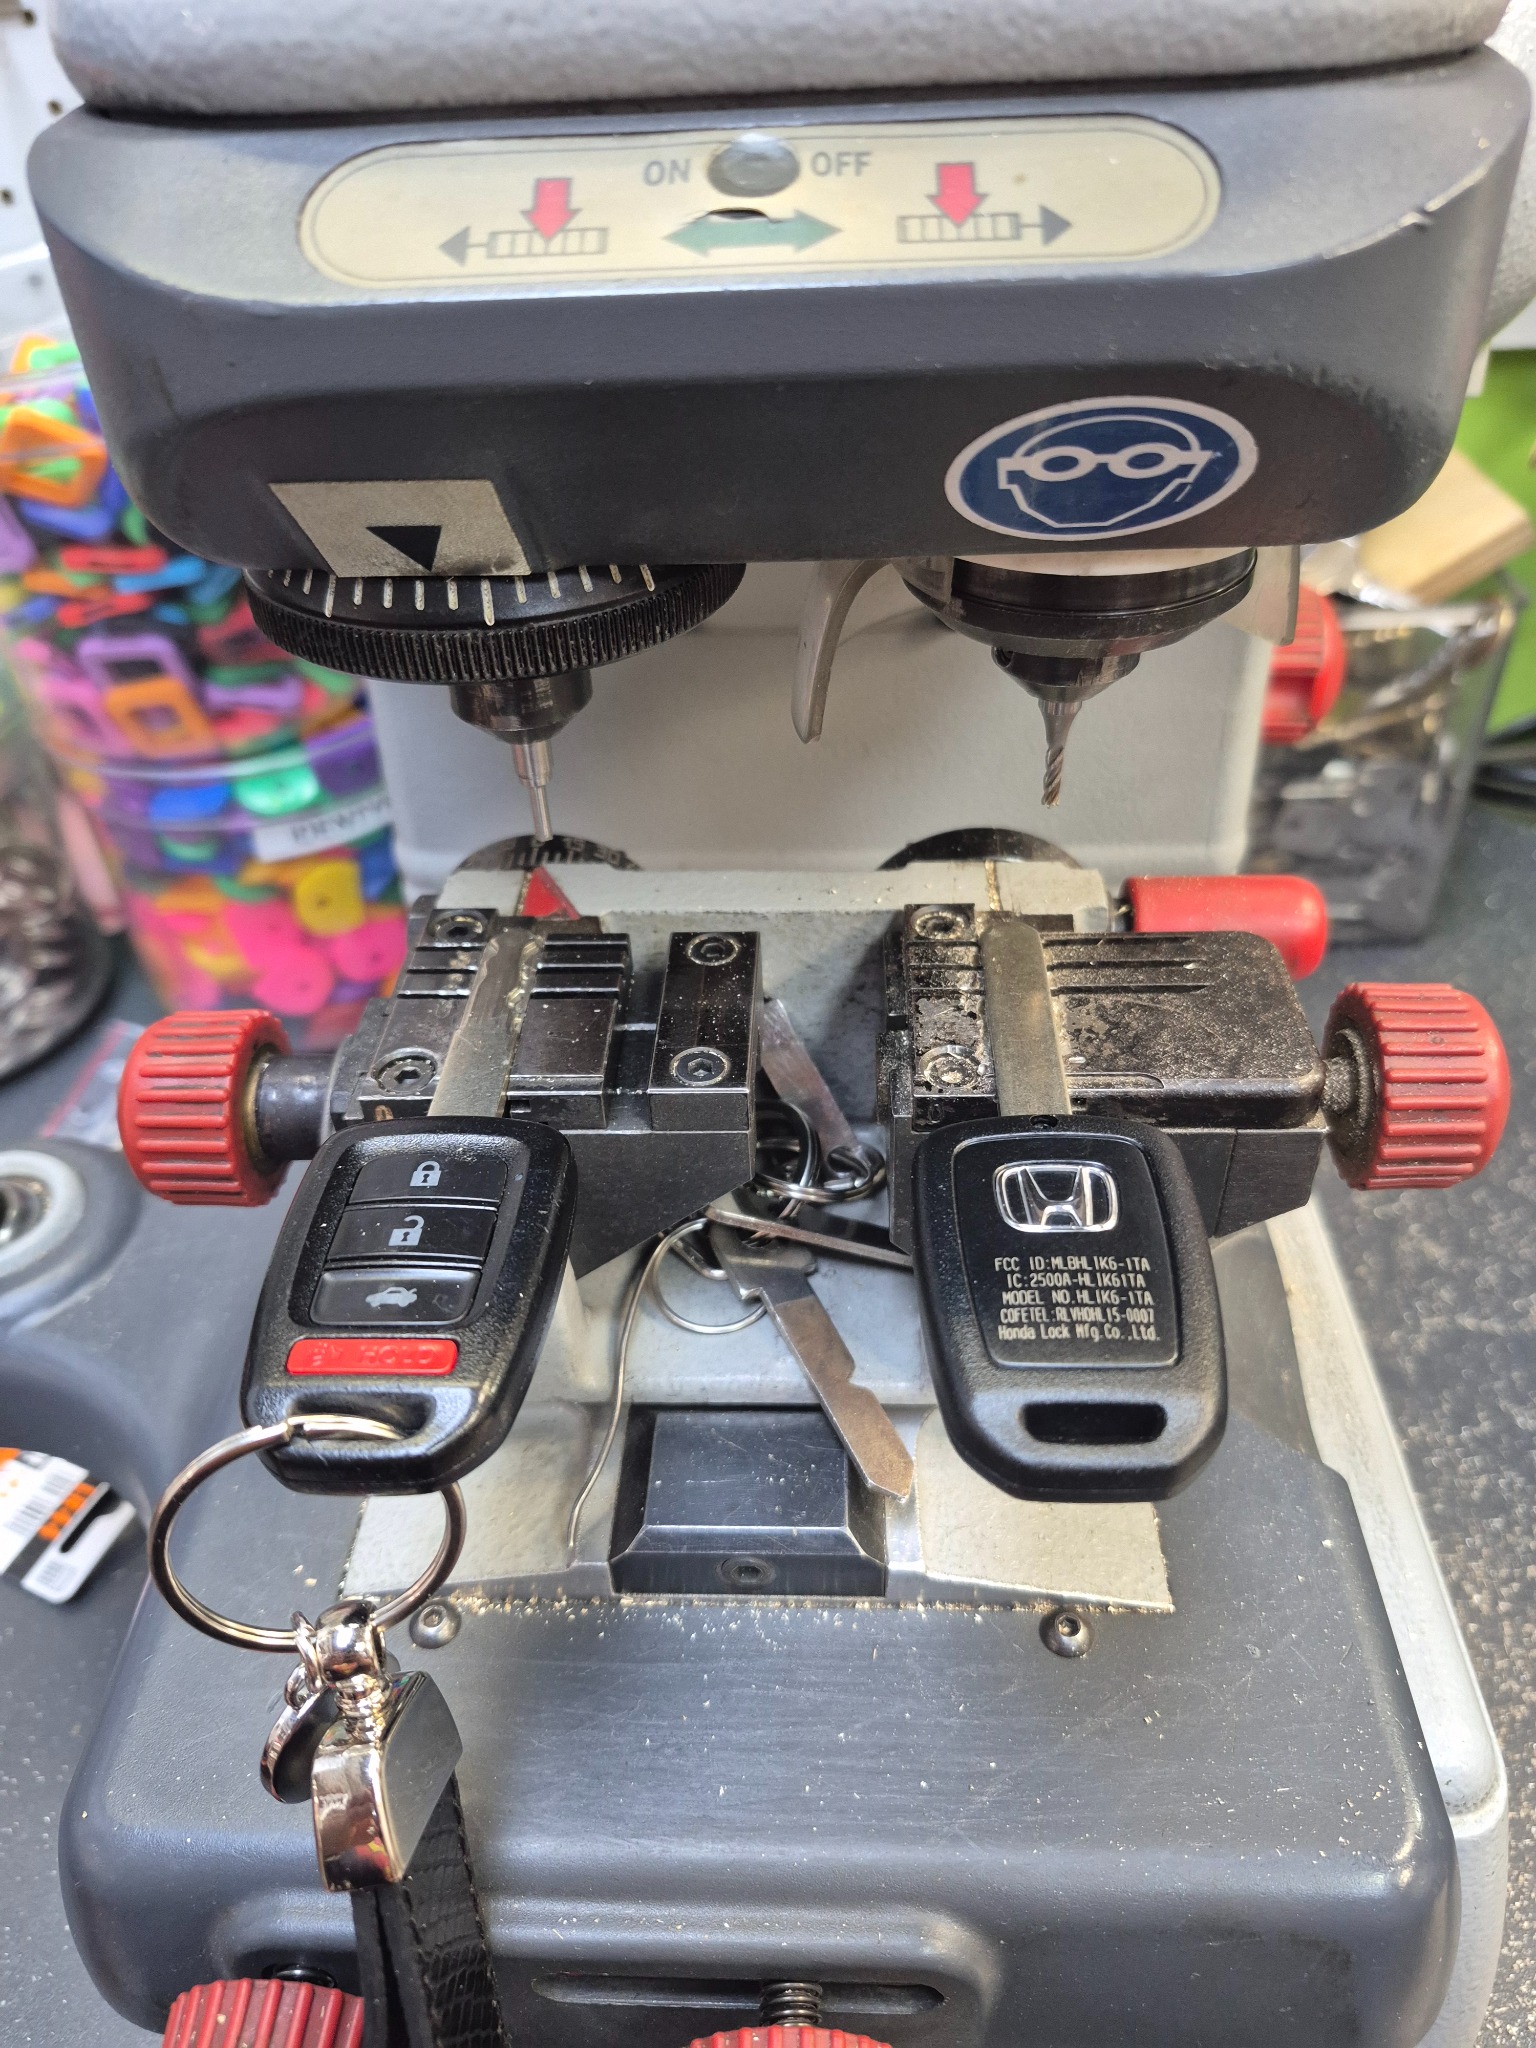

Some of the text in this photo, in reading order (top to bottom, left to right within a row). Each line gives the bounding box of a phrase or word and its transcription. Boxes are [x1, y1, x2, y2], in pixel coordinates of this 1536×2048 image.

[643, 159, 691, 186] ON
[811, 152, 872, 177] OFF
[994, 1257, 1020, 1272] FCC
[1002, 1290, 1045, 1306] MODEL
[998, 1325, 1036, 1341] Honda
[1040, 1324, 1071, 1340] Lock
